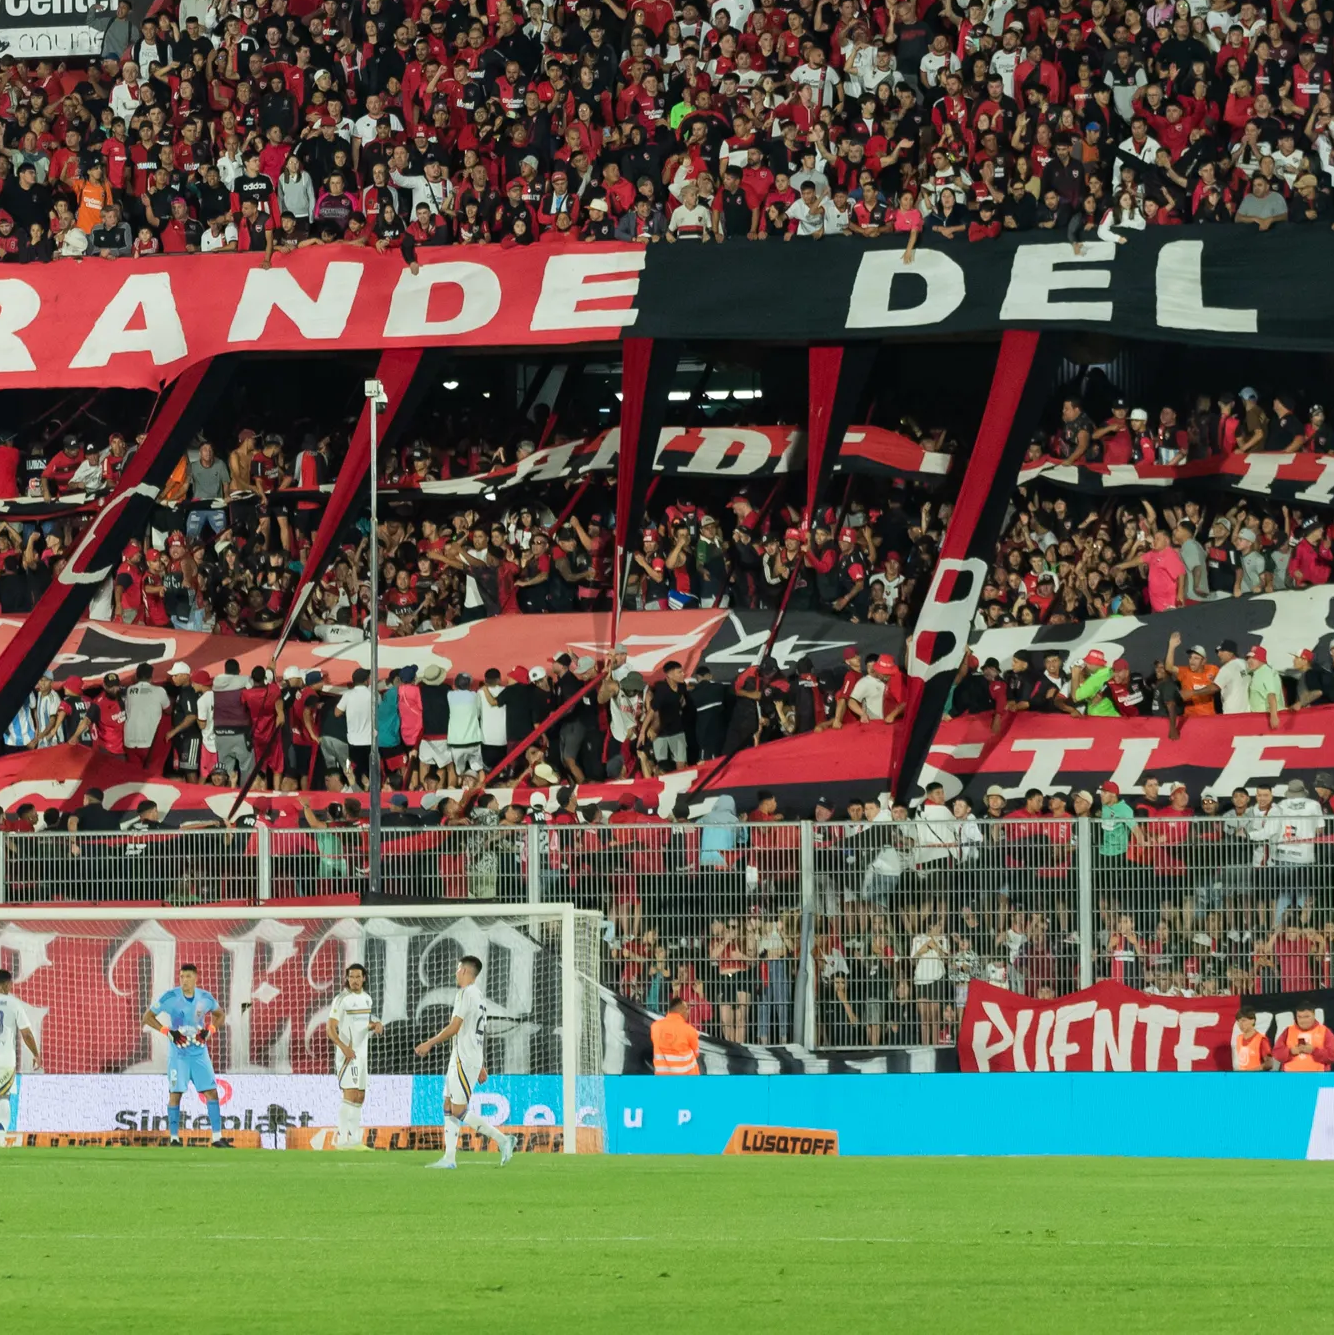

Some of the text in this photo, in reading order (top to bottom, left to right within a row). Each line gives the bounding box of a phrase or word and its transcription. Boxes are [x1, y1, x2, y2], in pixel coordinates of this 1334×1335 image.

[242, 182, 267, 191] adidas
[845, 240, 1258, 333] DEL
[972, 1000, 1220, 1072] PUENTE
[350, 1067, 359, 1077] 10
[742, 1130, 835, 1155] LÜSQTOFF
